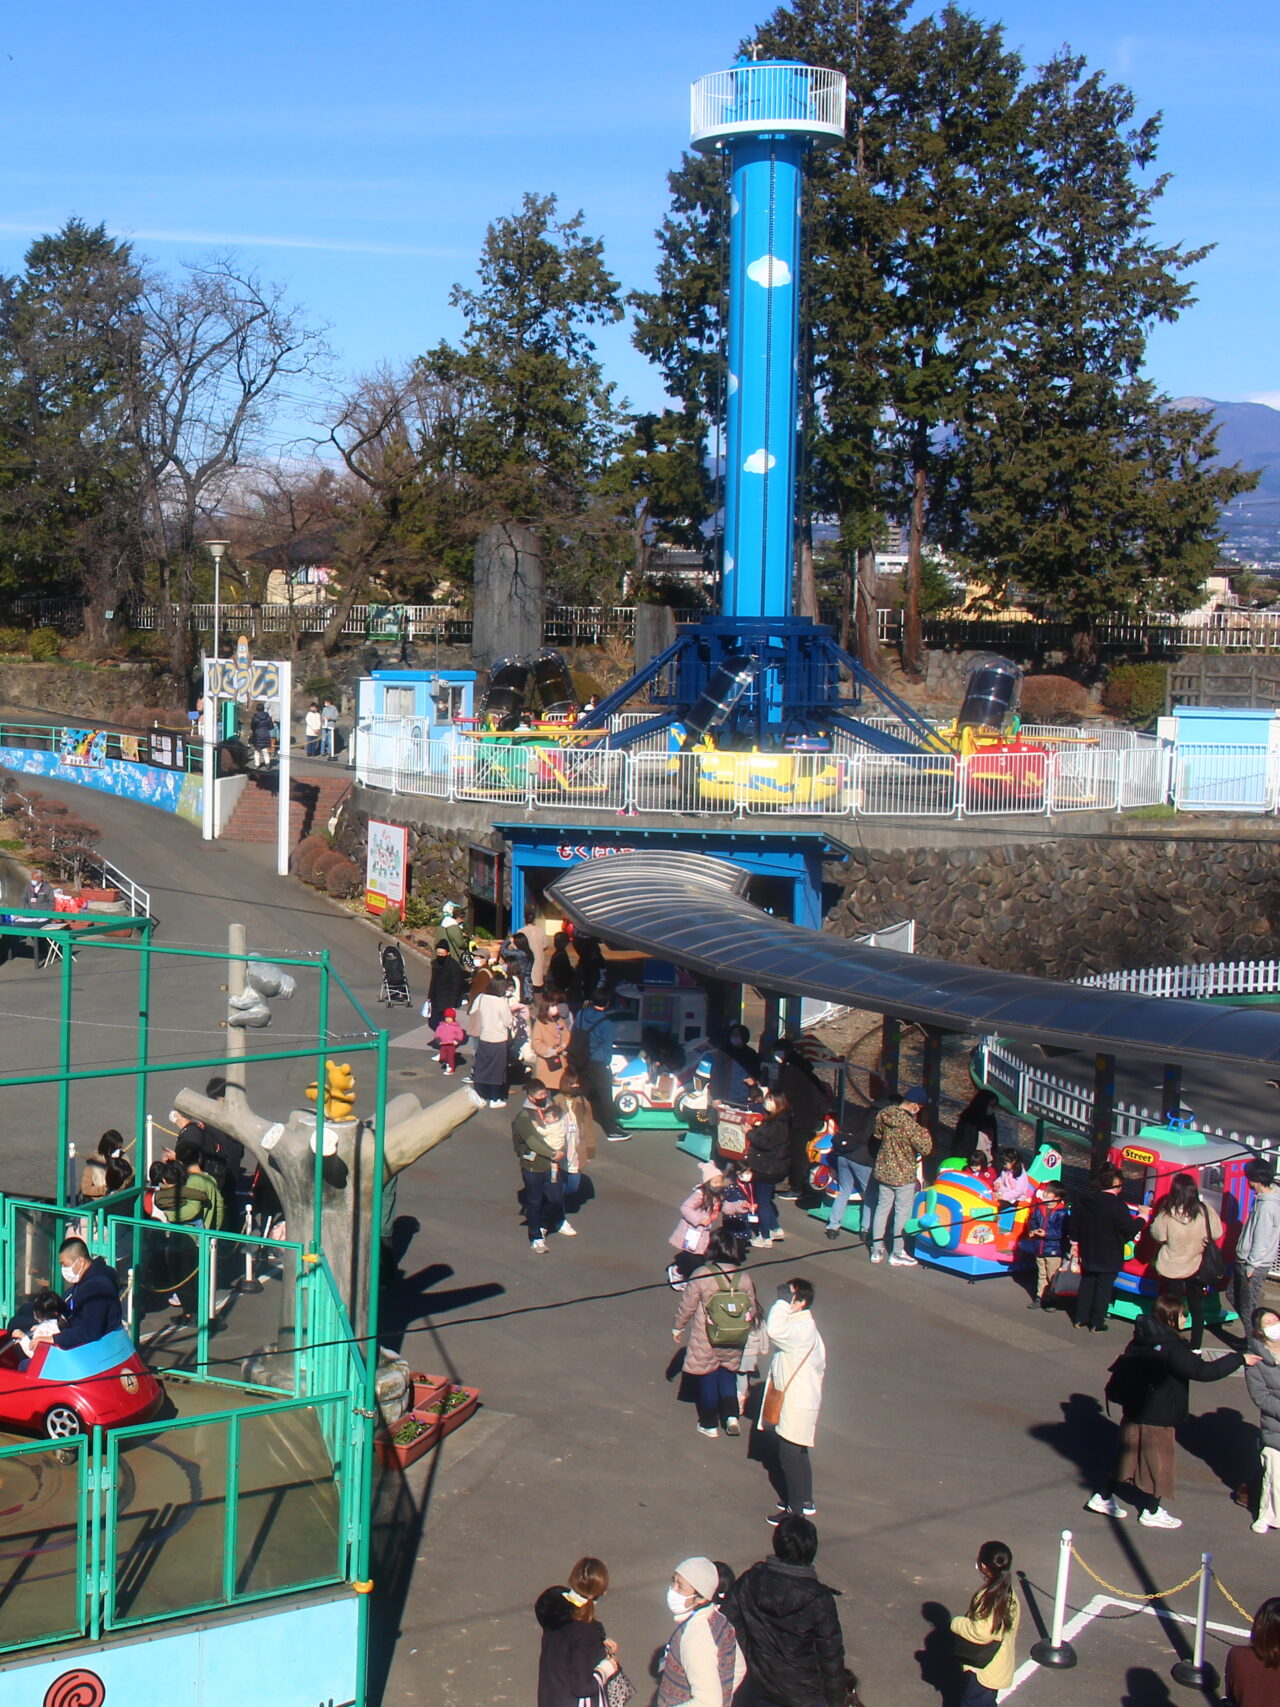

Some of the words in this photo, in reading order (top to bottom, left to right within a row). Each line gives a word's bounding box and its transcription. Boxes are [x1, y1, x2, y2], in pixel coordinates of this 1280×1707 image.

[208, 660, 279, 699] ひこうとう
[1124, 1149, 1152, 1163] Street
[126, 1374, 135, 1387] 4
